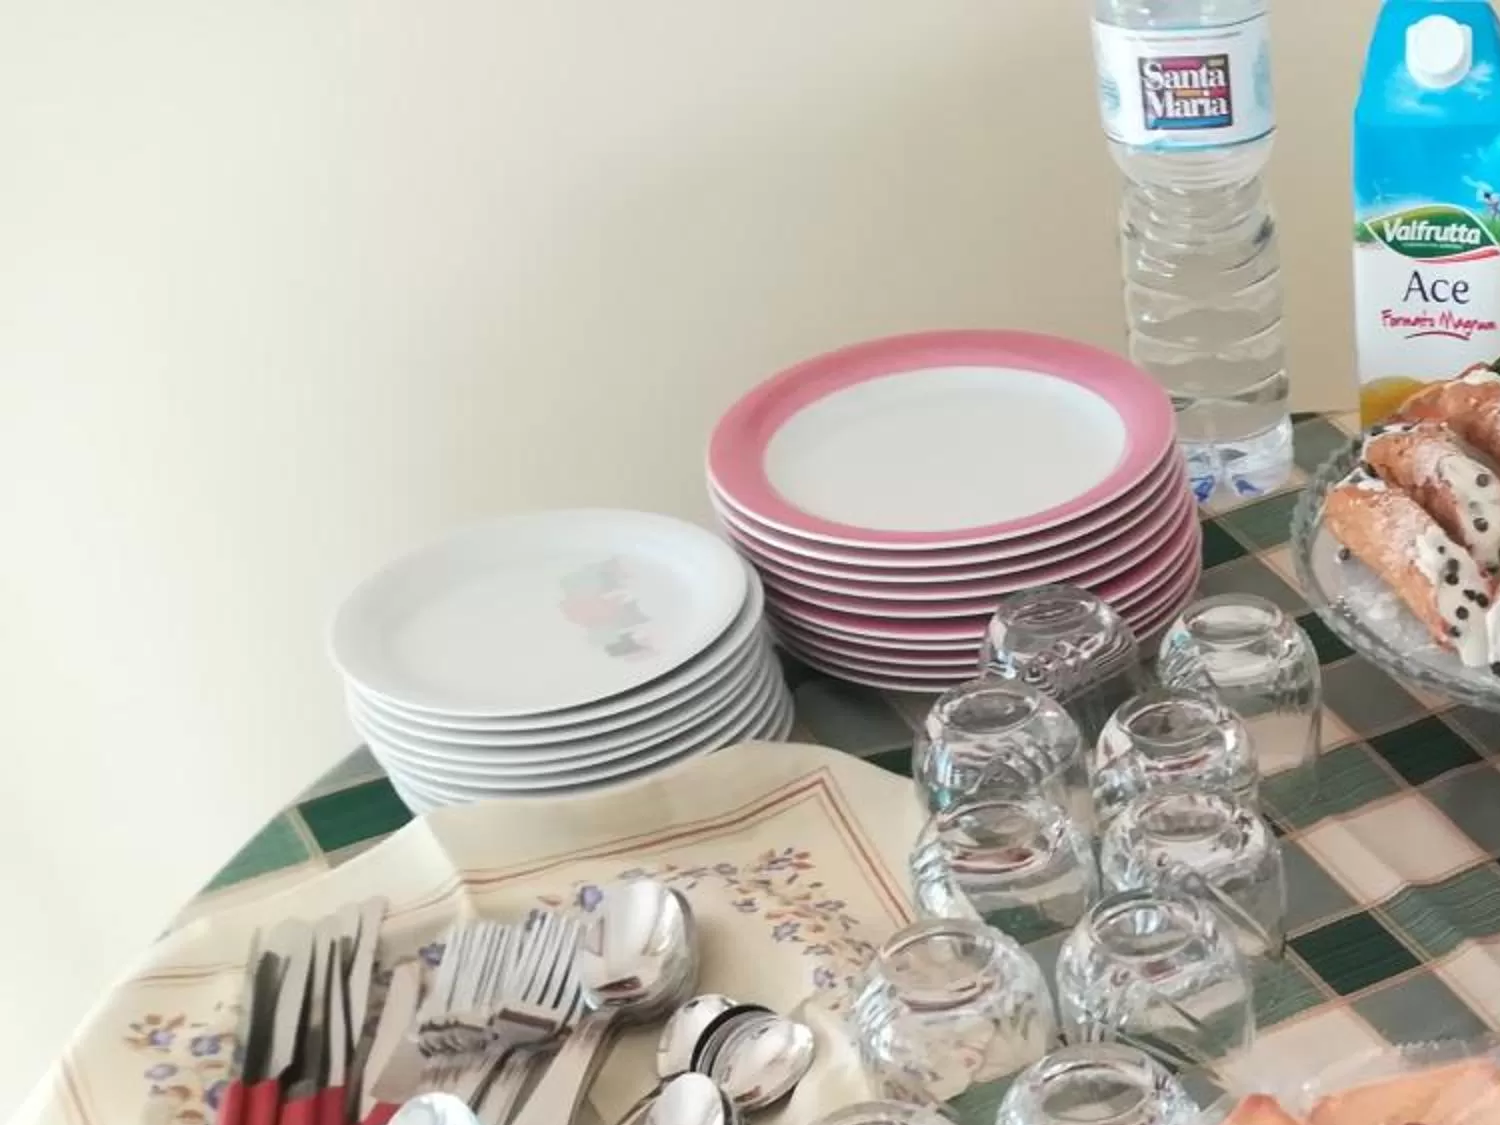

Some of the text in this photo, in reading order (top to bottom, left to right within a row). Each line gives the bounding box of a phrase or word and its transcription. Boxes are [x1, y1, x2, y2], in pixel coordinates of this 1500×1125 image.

[1143, 63, 1225, 90] Santa
[1145, 89, 1229, 118] Maria
[1383, 218, 1481, 245] Valfrutta
[1402, 269, 1470, 304] Ace
